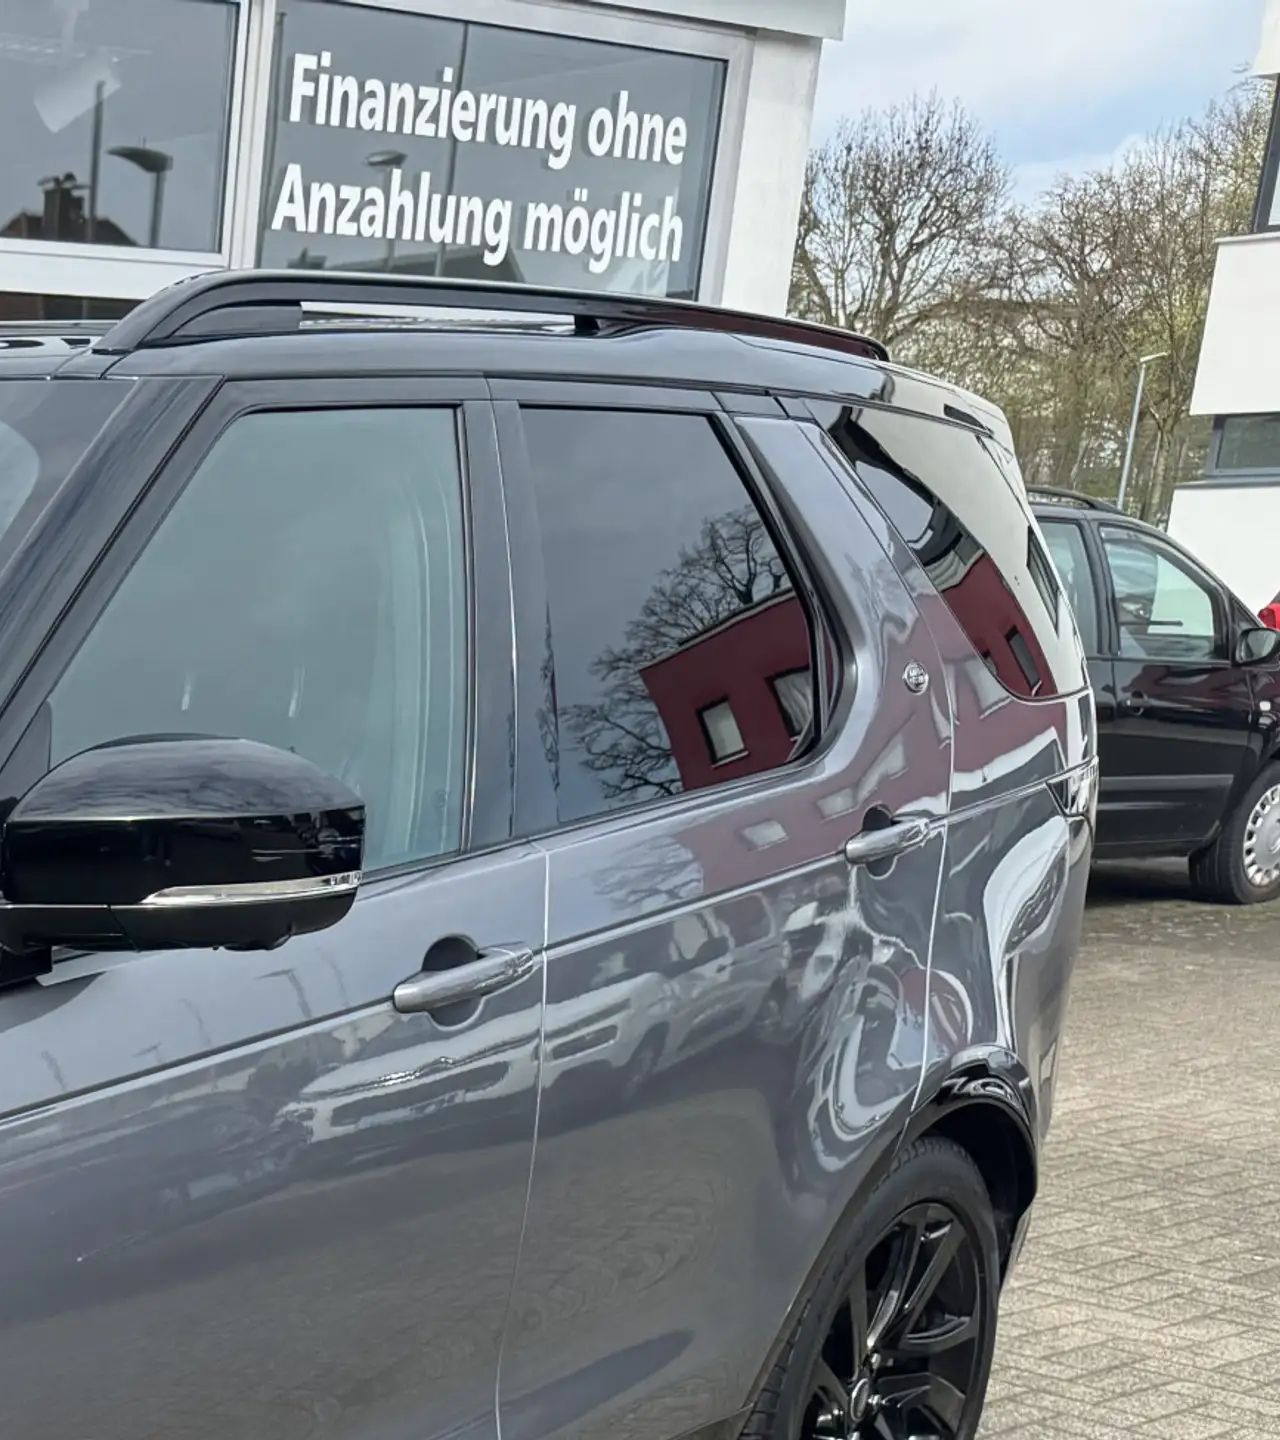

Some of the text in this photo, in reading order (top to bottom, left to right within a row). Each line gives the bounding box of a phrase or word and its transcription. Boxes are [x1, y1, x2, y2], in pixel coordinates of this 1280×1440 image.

[289, 51, 688, 170] Finanzierung ohne
[271, 162, 683, 274] Anzahlung möglich
